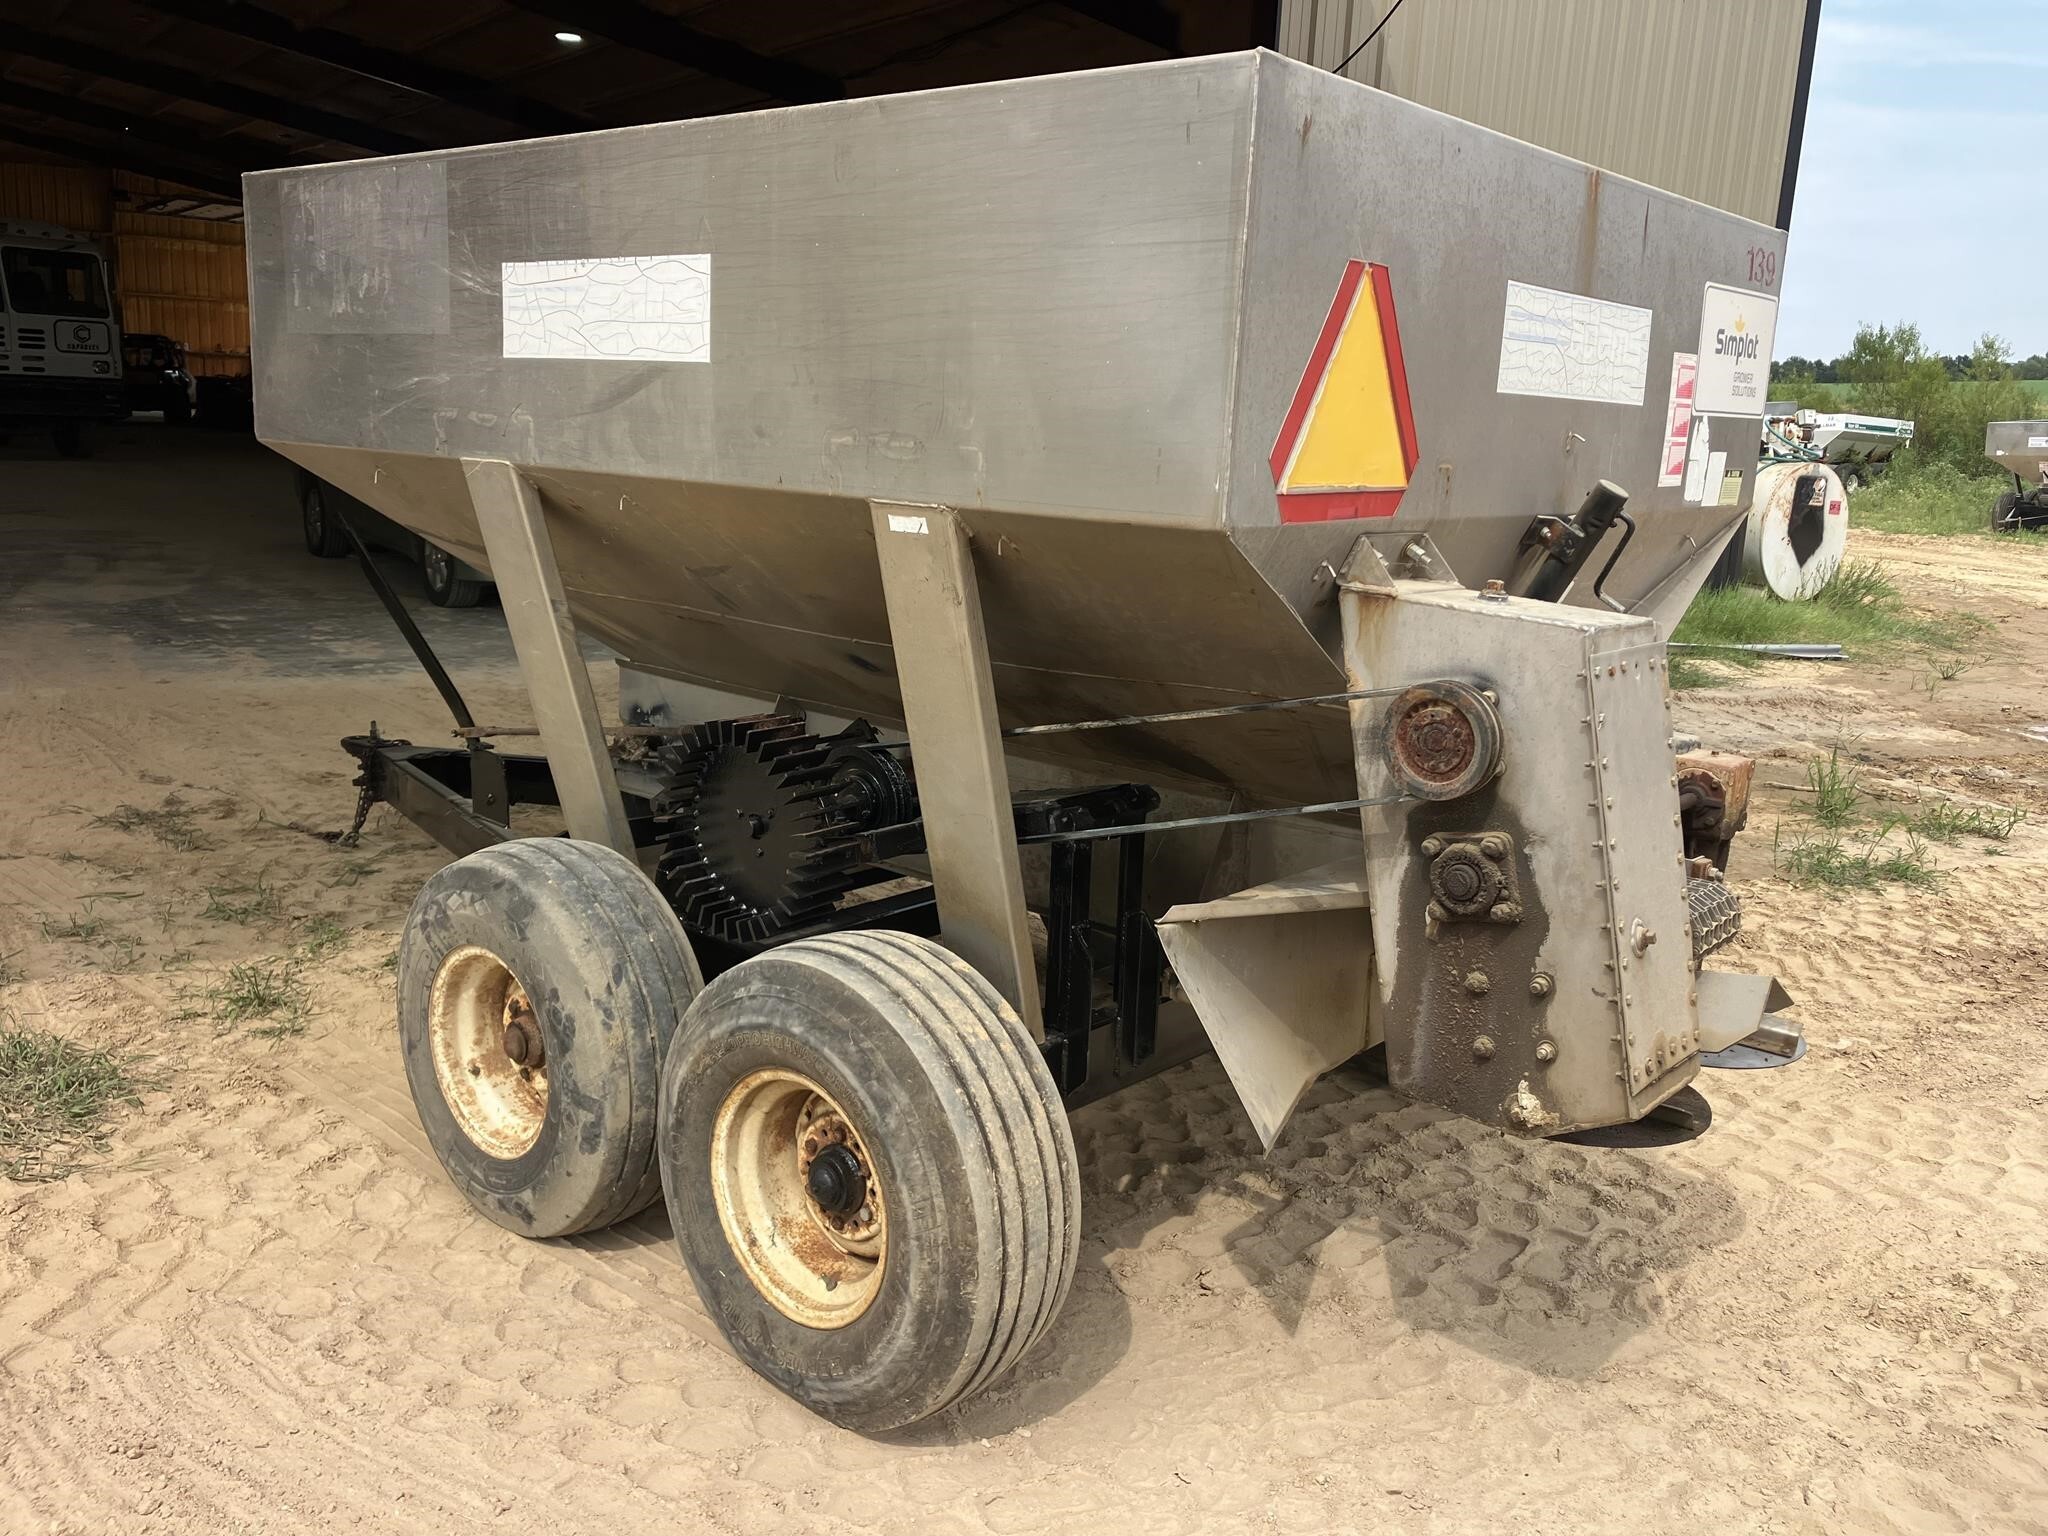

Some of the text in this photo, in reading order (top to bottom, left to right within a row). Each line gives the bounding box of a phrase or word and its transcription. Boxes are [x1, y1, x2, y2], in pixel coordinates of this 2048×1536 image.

[1747, 245, 1776, 287] 139
[1714, 328, 1759, 366] Simplot
[1733, 371, 1754, 384] GROWER
[1731, 385, 1757, 398] SOLUTIONS
